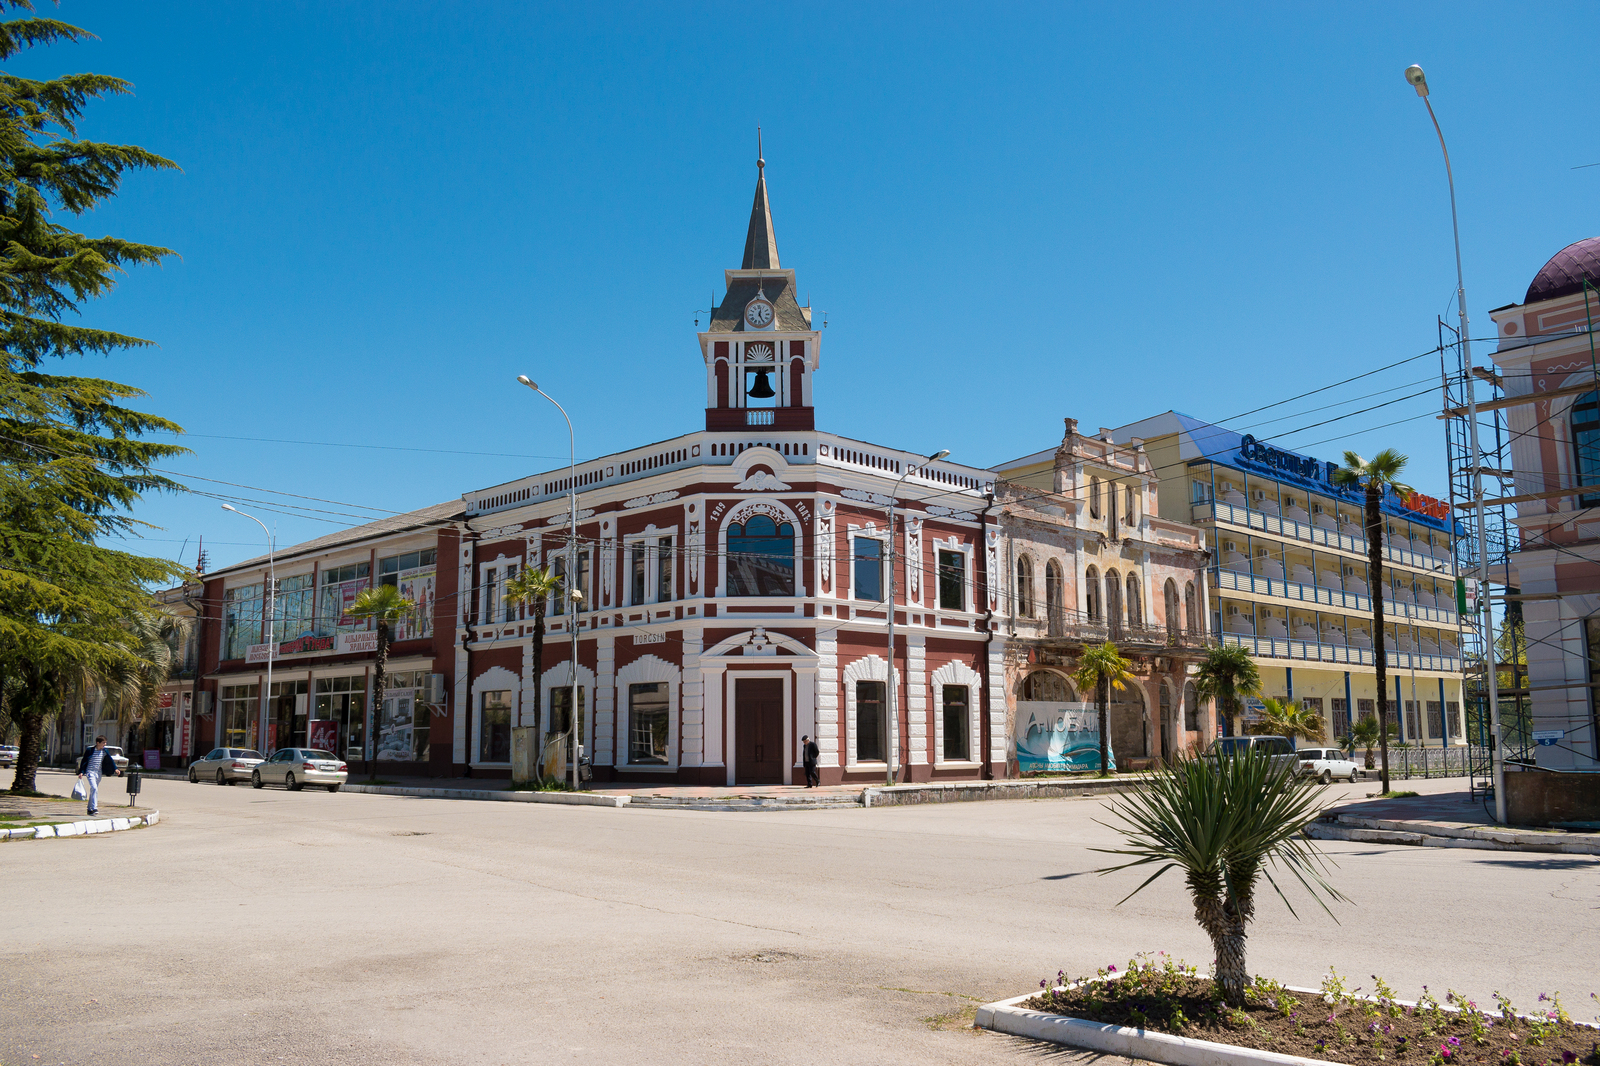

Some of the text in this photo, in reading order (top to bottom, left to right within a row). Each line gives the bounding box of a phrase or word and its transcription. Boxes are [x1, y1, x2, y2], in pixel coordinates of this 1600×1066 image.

[1241, 434, 1319, 480] Светлый
[710, 502, 726, 521] 1909
[349, 641, 376, 651] ЯРМАРКА
